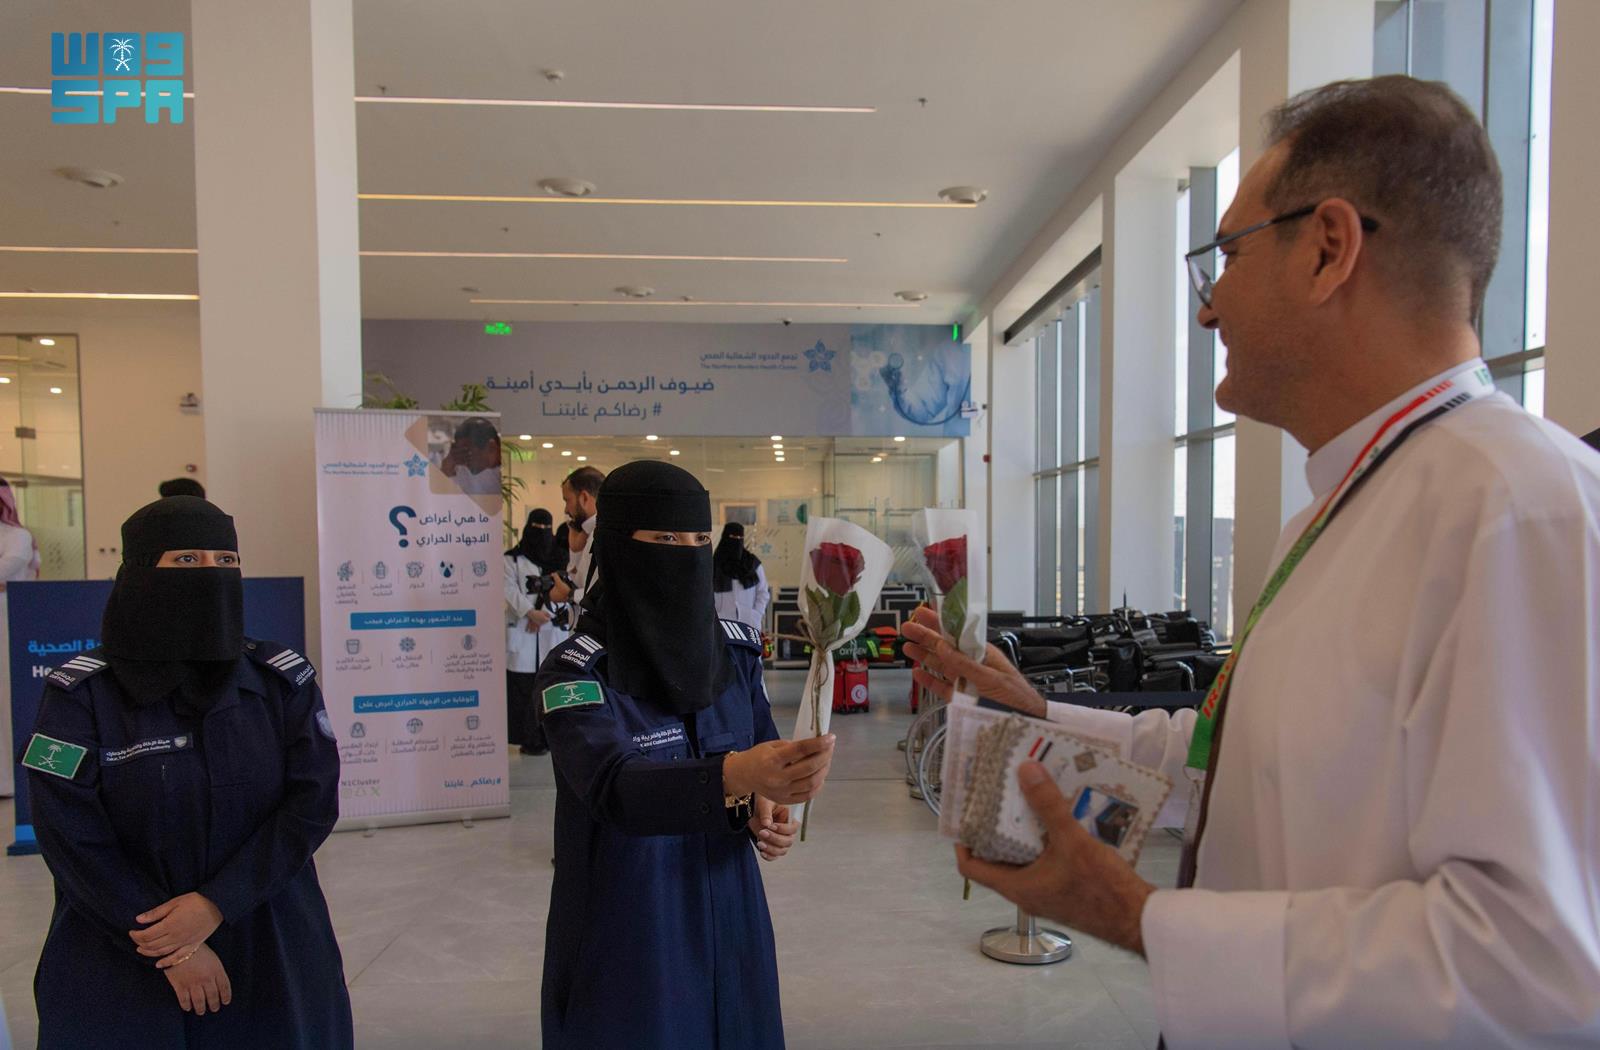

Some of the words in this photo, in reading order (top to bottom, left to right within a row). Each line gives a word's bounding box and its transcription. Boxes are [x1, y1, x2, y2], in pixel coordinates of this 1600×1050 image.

[485, 371, 535, 394] أمينة
[538, 371, 593, 396] بأيدي
[597, 375, 655, 394] الرحمن
[658, 377, 715, 394] ضيوف
[541, 402, 589, 418] غايتنا
[593, 402, 648, 422] رضاكم
[418, 510, 452, 526] أعراض
[454, 515, 476, 527] هي
[479, 513, 490, 524] ما
[416, 533, 452, 547] الحراري
[28, 639, 83, 657] الصحية
